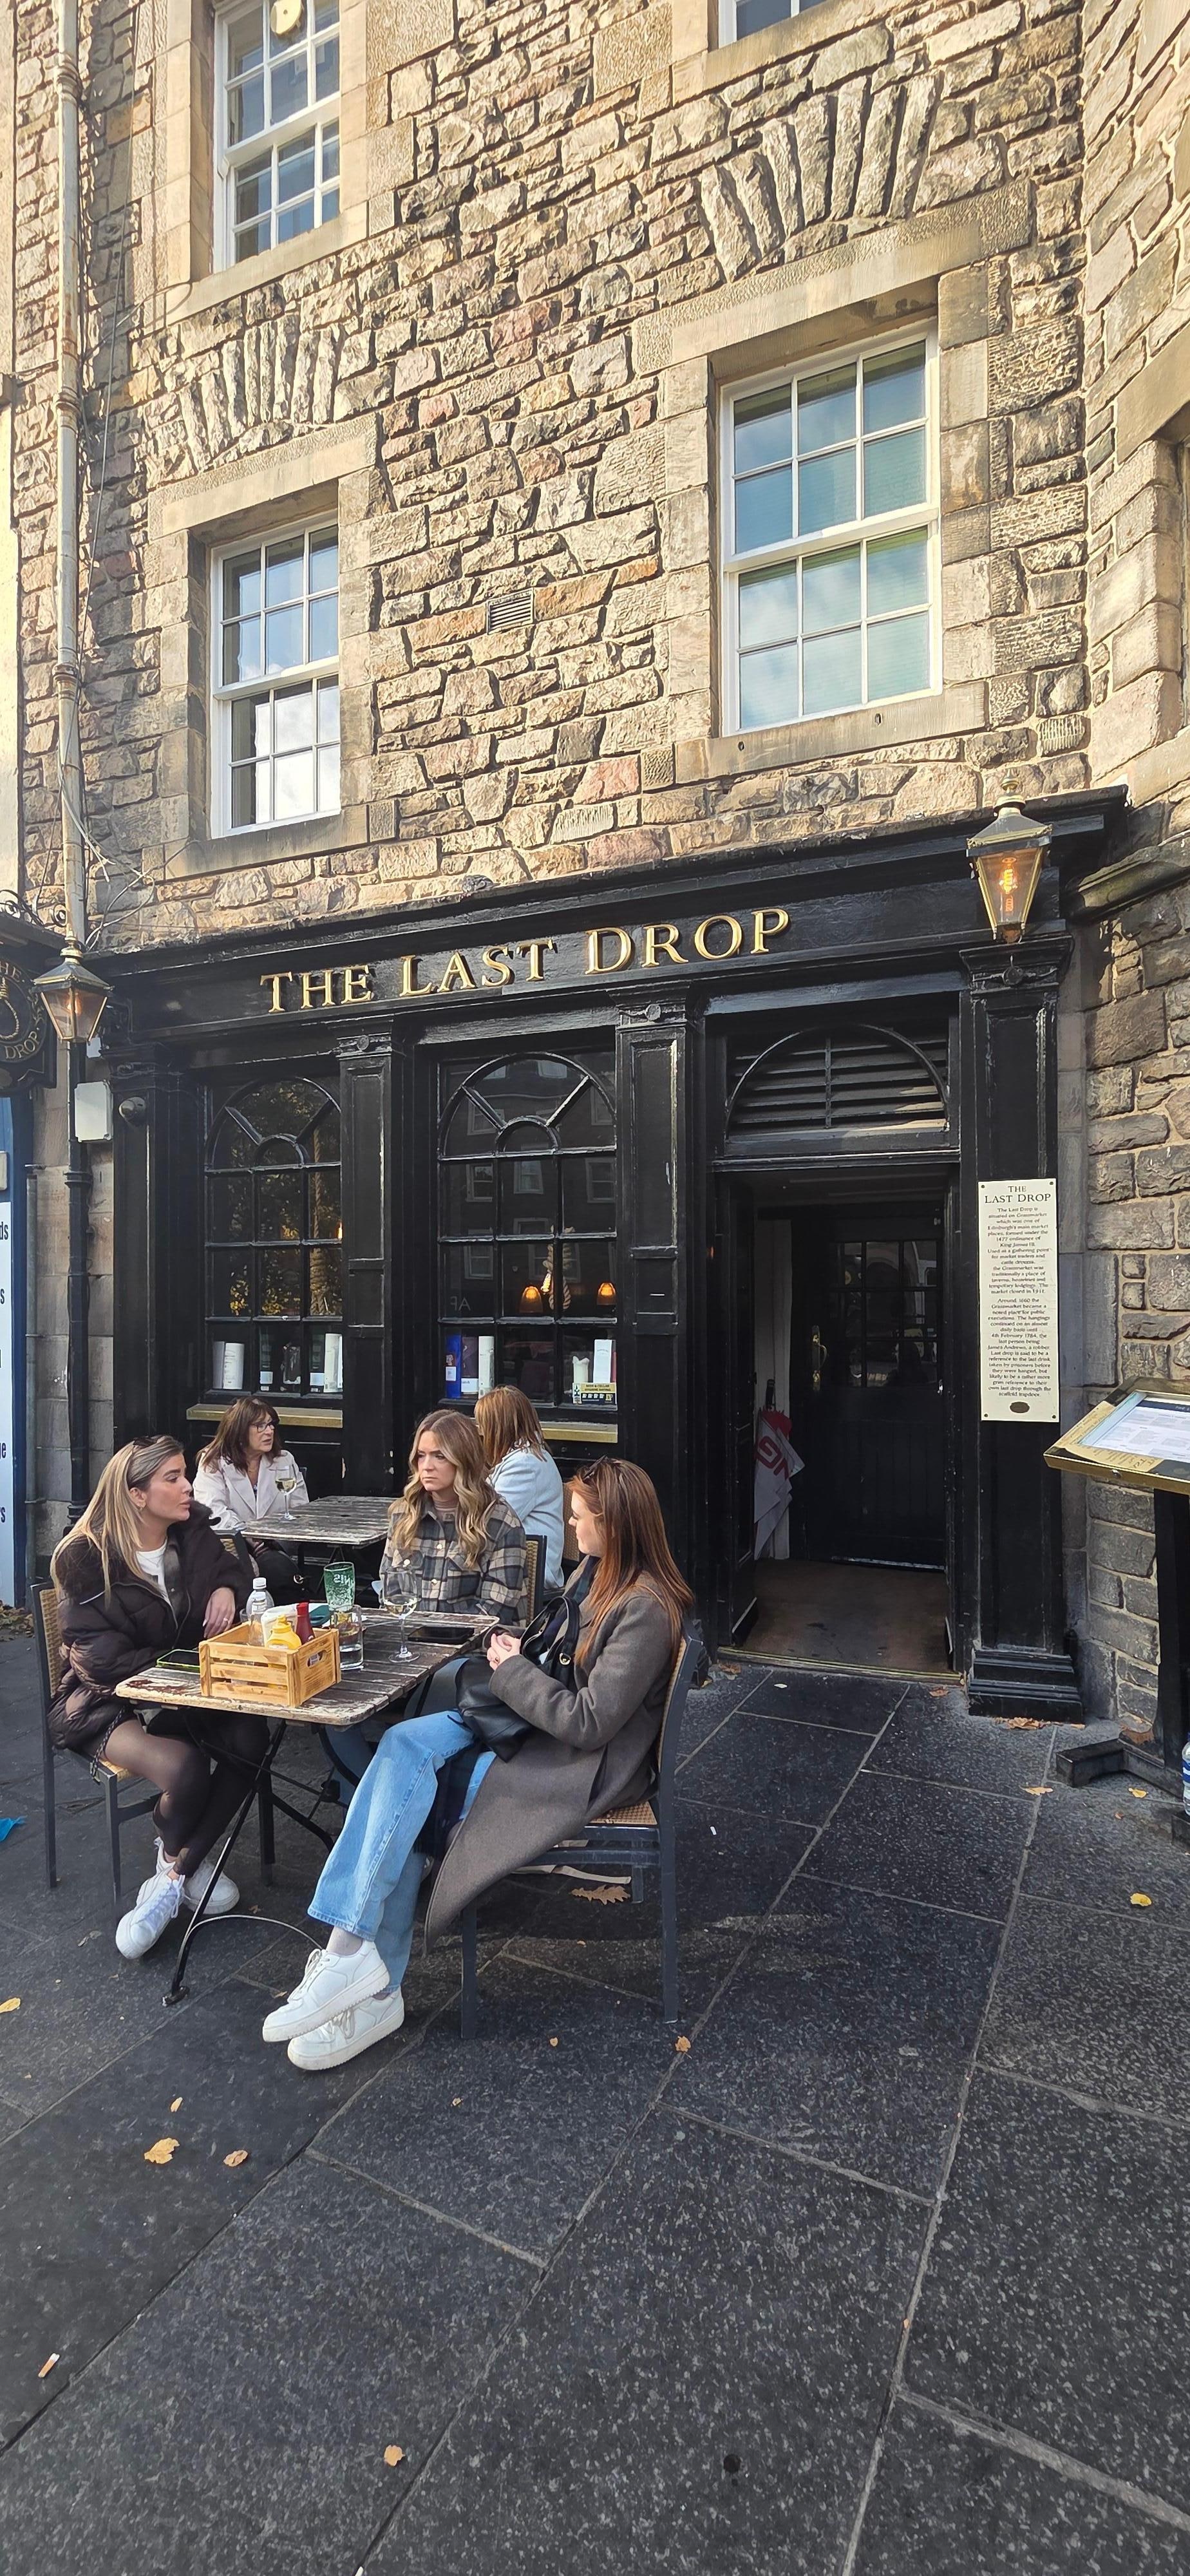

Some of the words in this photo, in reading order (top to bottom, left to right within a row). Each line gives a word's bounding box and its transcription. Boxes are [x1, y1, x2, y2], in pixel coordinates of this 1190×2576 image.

[261, 967, 373, 1013] THE
[399, 940, 556, 998] LAST
[585, 908, 792, 975] DROP
[5, 1030, 41, 1059] DROP
[985, 1195, 1013, 1204] LAST
[1017, 1193, 1051, 1202] DROP
